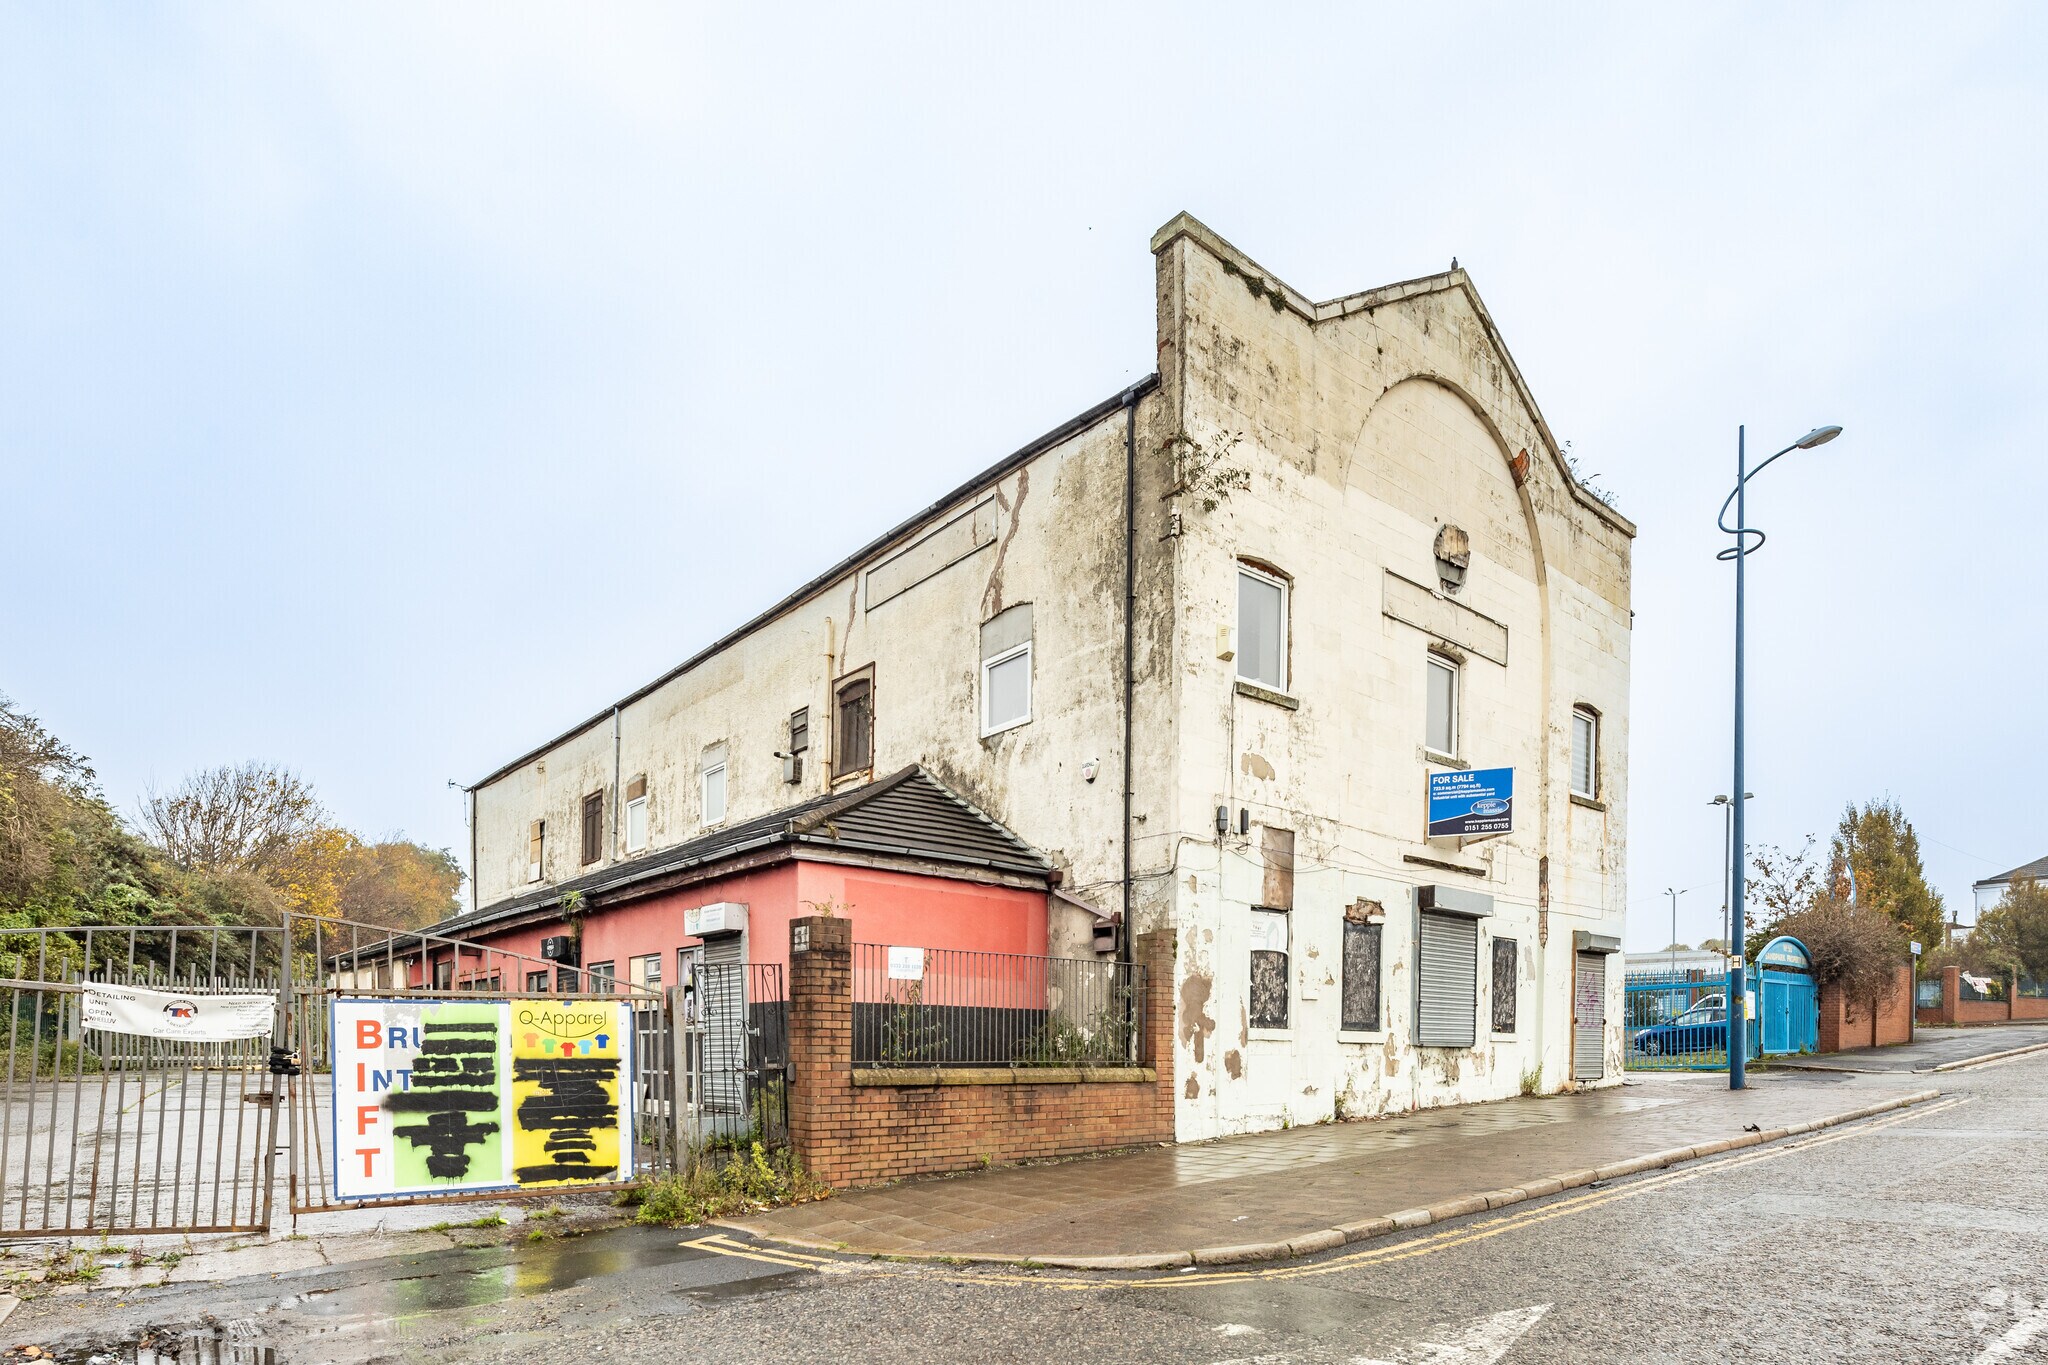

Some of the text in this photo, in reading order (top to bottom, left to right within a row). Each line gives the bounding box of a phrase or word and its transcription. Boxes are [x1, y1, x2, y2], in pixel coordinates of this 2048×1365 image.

[1433, 774, 1474, 784] FOR SALE
[1477, 801, 1497, 809] keppie
[1732, 956, 1741, 967] H
[88, 989, 136, 1001] DETAILING
[88, 999, 109, 1007] UNIT
[88, 1008, 112, 1016] OPEN
[168, 1008, 193, 1018] TK
[519, 1010, 607, 1035] Q-Apparel
[357, 1105, 380, 1136] F
[355, 1148, 381, 1178] T
